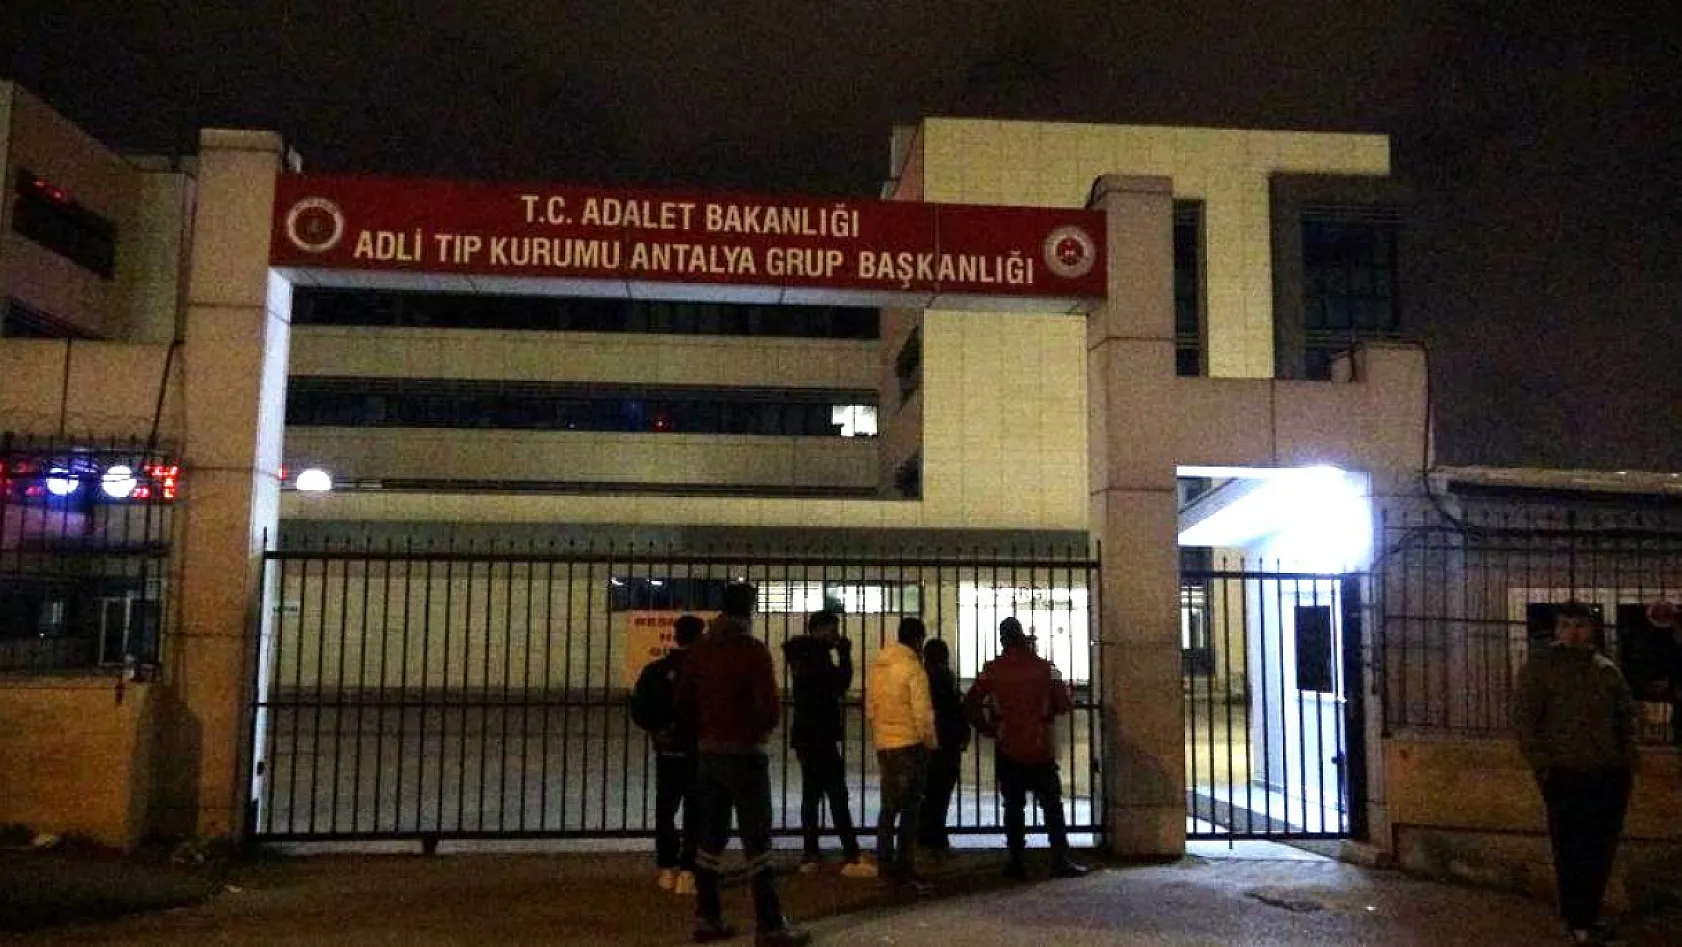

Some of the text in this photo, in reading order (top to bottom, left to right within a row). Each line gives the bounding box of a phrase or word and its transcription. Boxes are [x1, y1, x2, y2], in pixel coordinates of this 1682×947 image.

[521, 196, 858, 237] T.C. ADALET BAKANLIĞI
[354, 229, 1033, 288] ADLİ TIP KURUMU ANTALYA GRUP BAŞKANLIĞI
